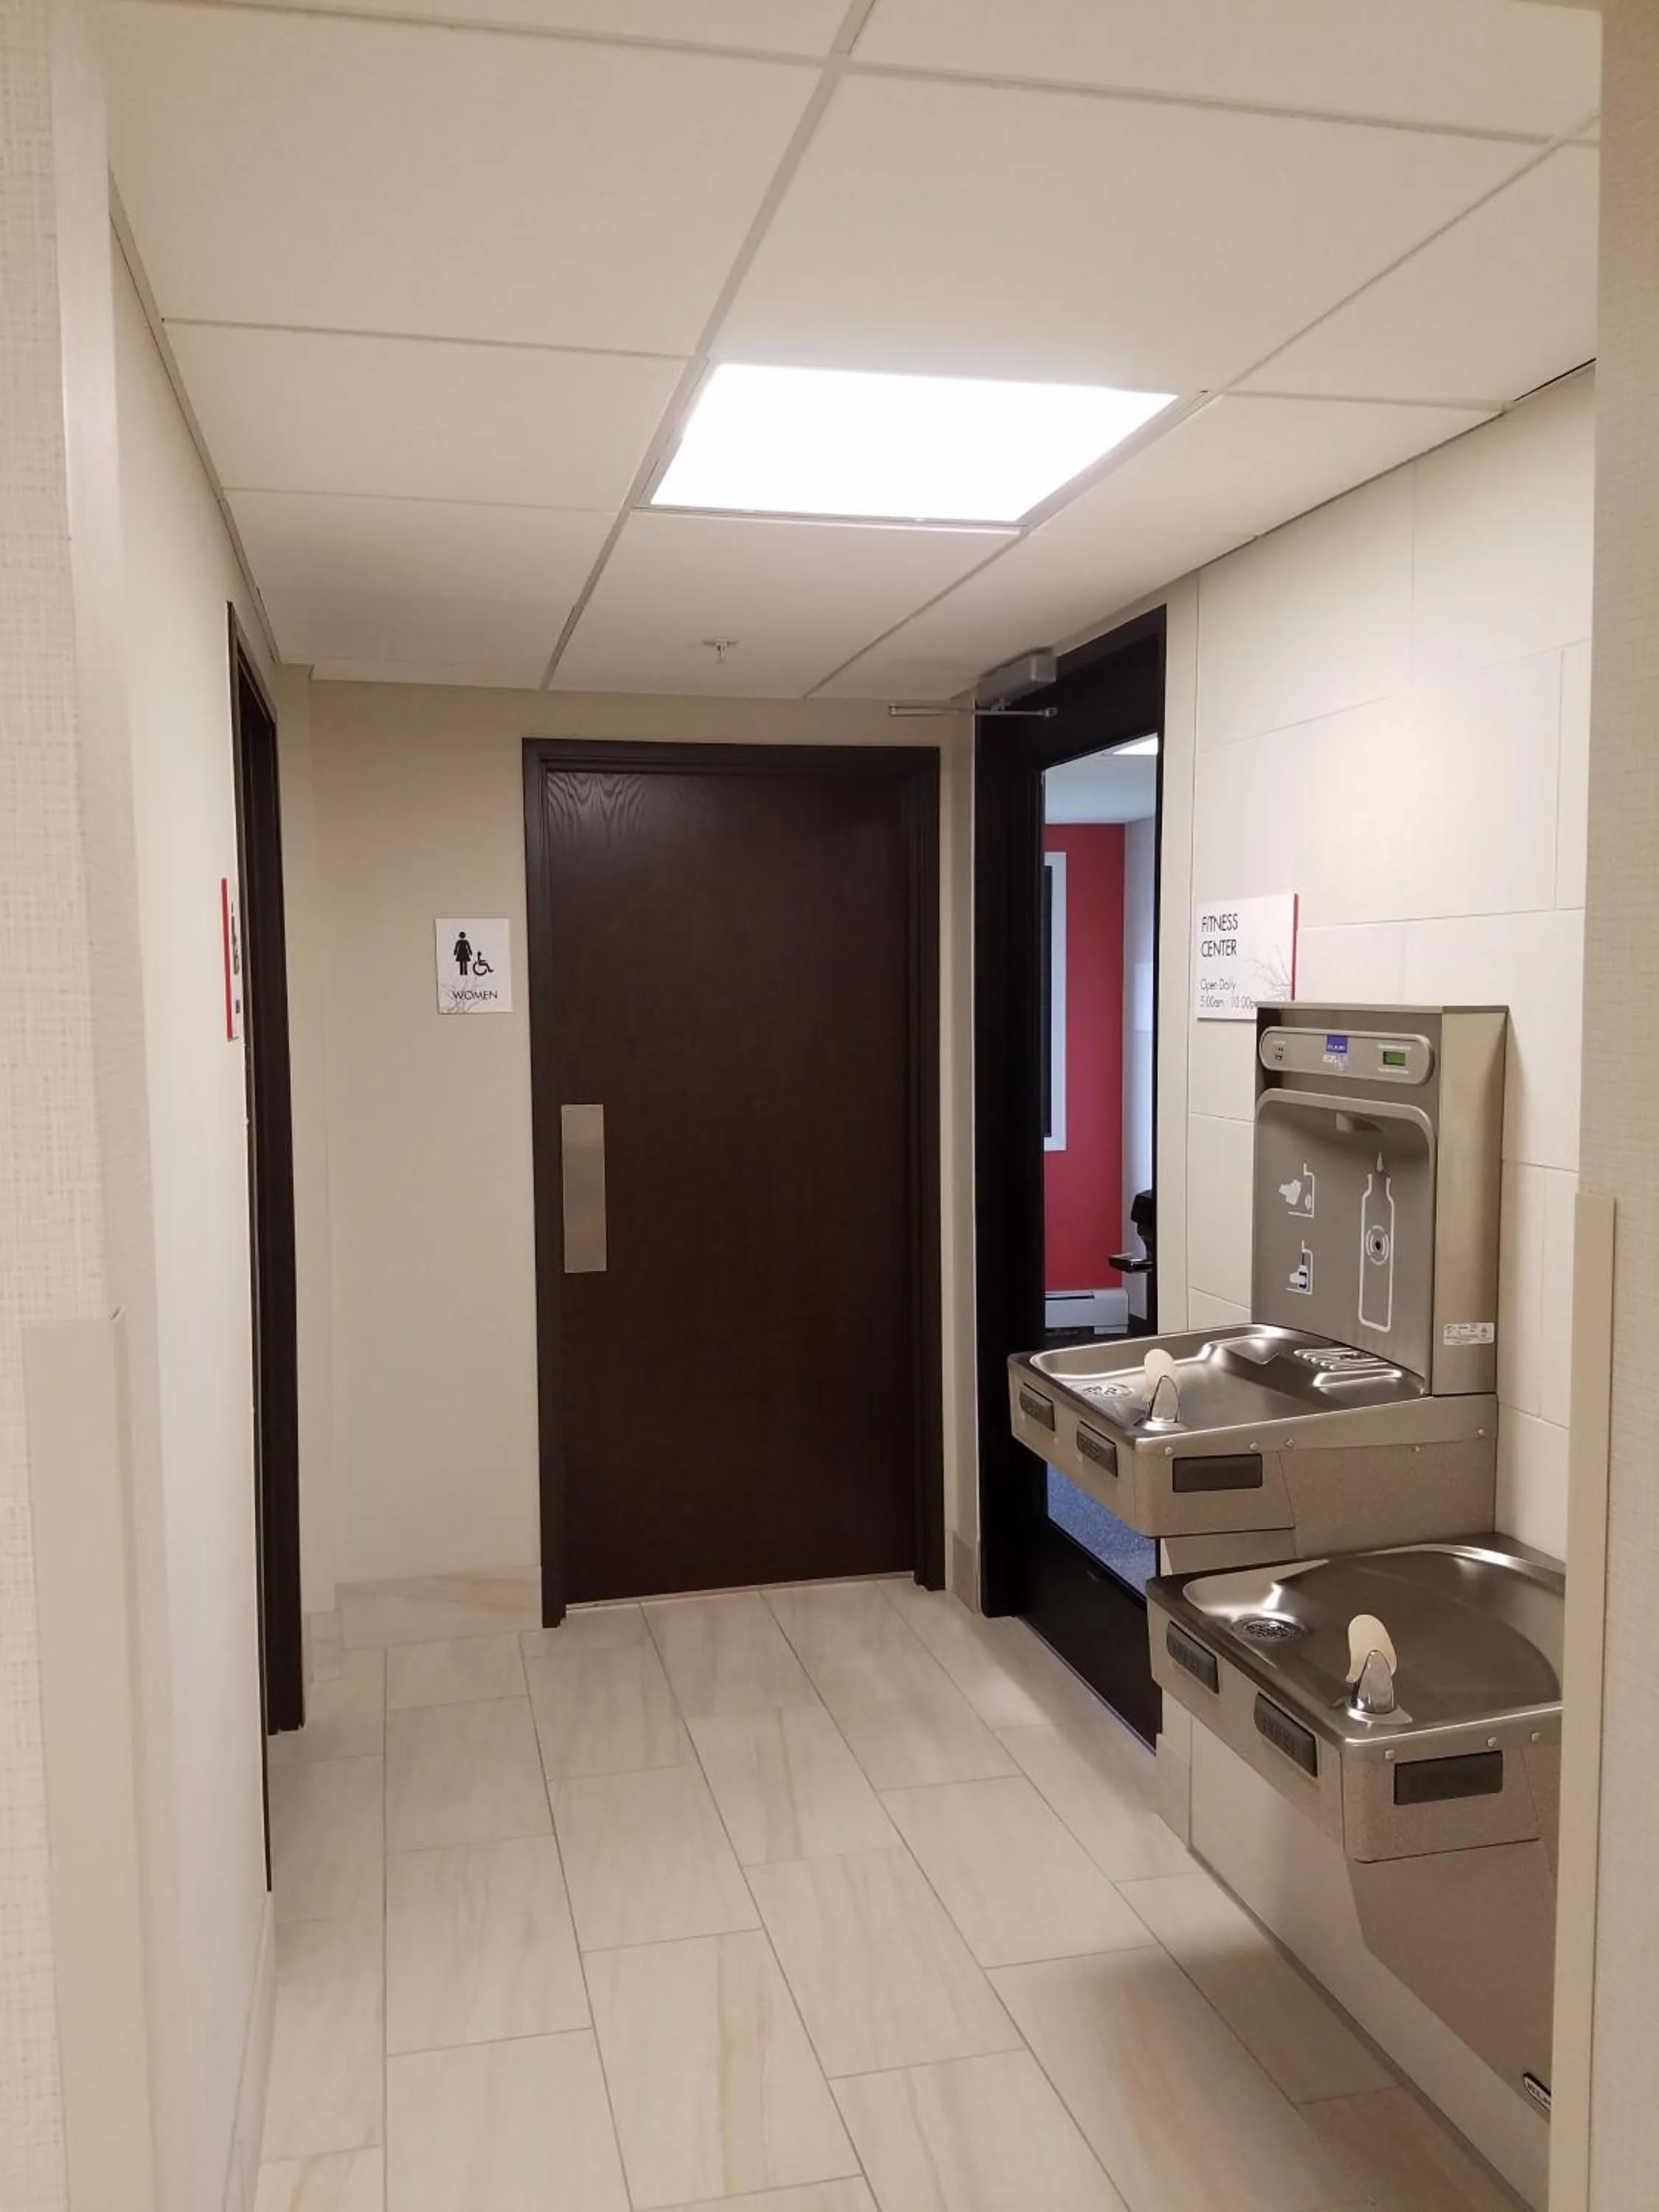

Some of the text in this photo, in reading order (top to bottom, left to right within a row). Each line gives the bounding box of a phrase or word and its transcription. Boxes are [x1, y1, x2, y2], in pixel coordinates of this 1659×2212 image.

[1201, 913, 1239, 932] FITNESS
[1201, 939, 1237, 958] CENTER
[451, 990, 498, 1001] WOMEN
